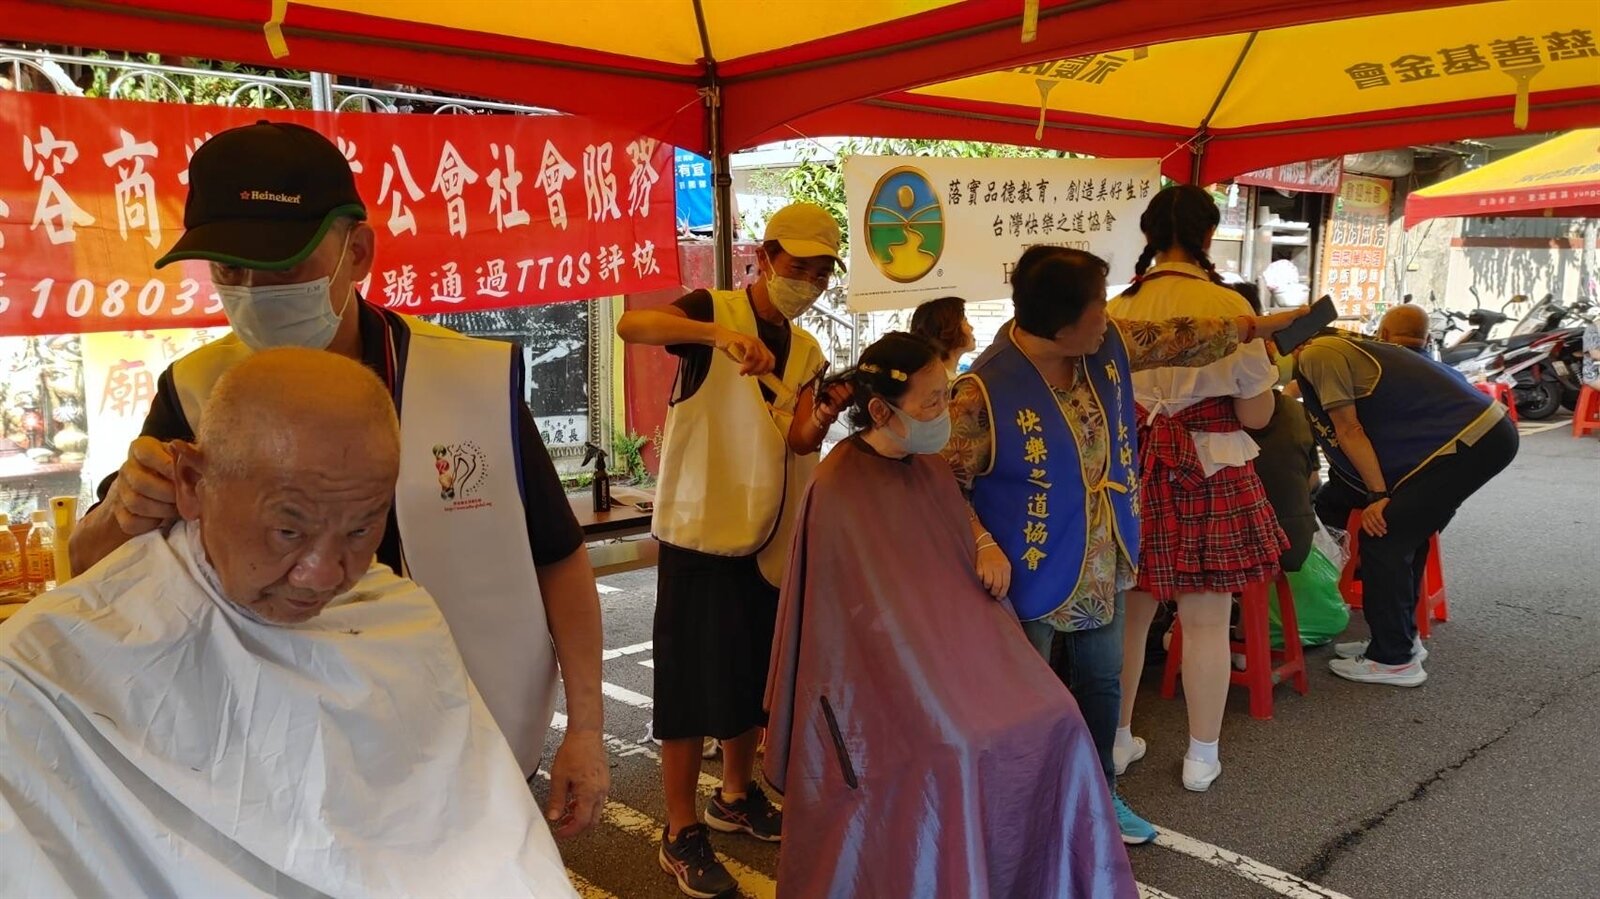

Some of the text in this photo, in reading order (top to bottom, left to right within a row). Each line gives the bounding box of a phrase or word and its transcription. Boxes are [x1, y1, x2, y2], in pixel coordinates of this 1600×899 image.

[251, 191, 300, 205] Heineken
[992, 209, 1117, 238] 台灣快樂之道協會
[1016, 408, 1053, 571] 快樂之道協會
